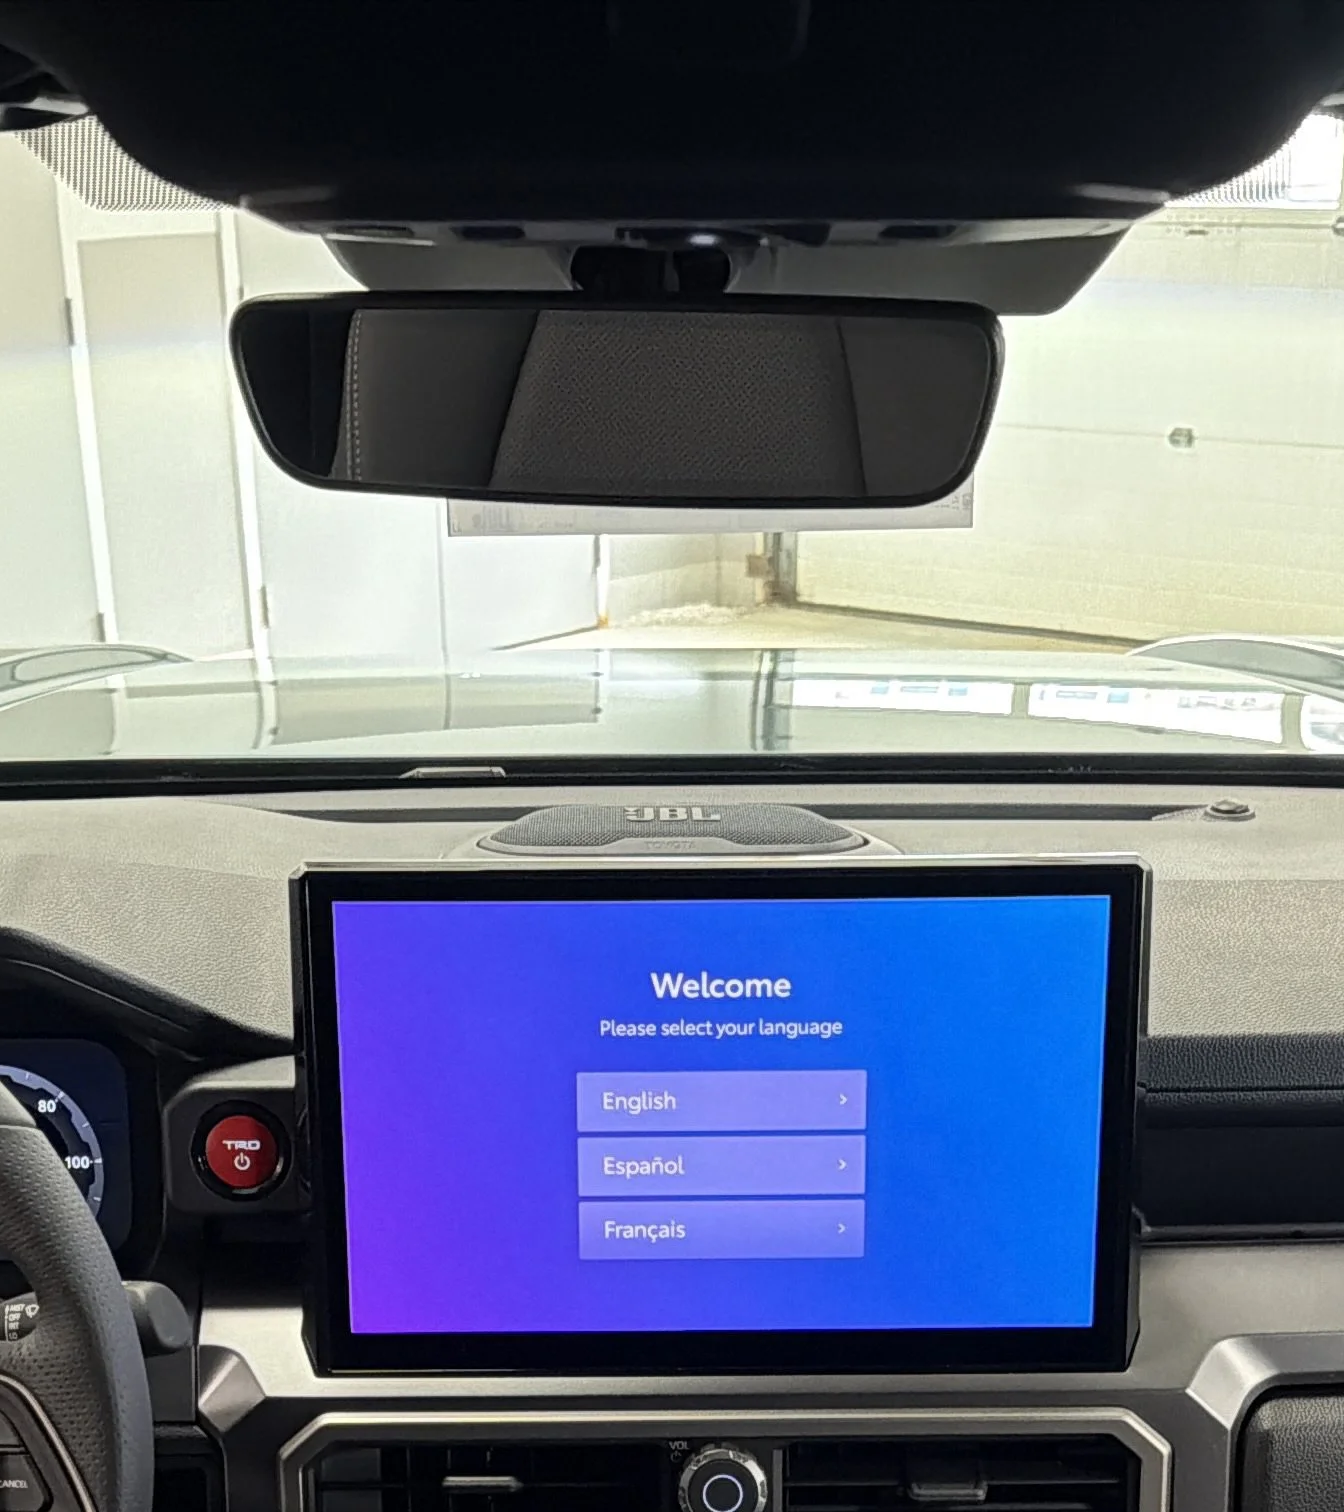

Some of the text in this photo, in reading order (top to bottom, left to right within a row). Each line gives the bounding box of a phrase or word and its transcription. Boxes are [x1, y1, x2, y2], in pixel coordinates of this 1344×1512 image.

[624, 806, 721, 822] JBL
[651, 971, 792, 999] Welcome
[600, 1018, 843, 1039] Please select your language
[37, 1099, 56, 1113] 80
[602, 1090, 677, 1115] English
[222, 1140, 261, 1151] TRD
[64, 1155, 90, 1169] 100
[603, 1156, 685, 1180] Español
[604, 1220, 686, 1244] Français
[668, 1440, 690, 1450] VOL
